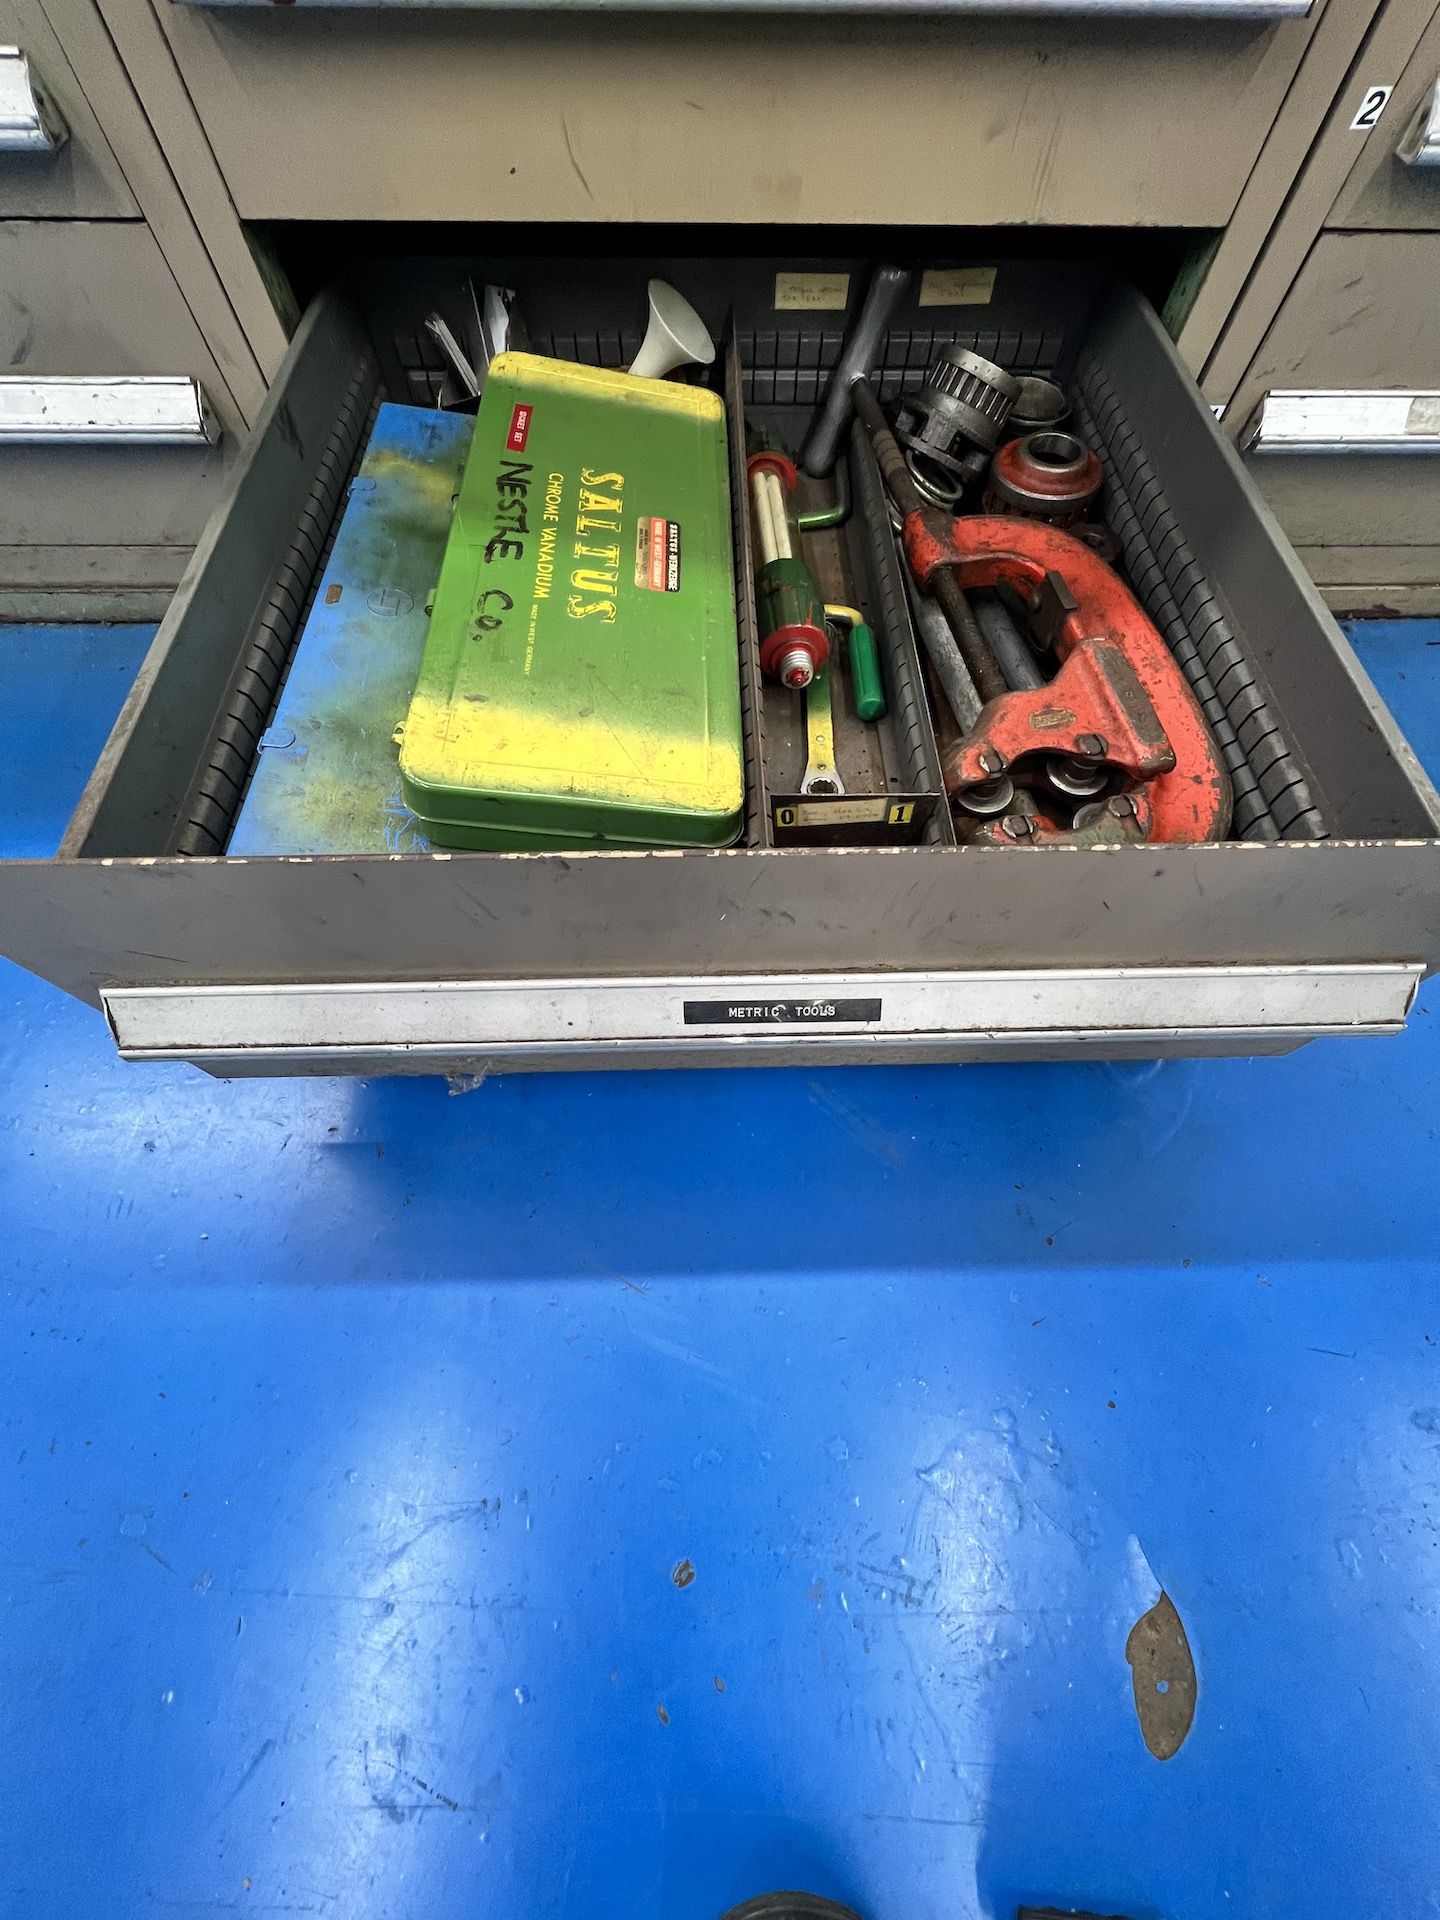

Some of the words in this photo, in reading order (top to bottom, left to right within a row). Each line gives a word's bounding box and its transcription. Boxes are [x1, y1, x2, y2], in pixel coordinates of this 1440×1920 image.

[1356, 90, 1386, 125] 2
[514, 431, 523, 443] SET
[484, 460, 534, 564] NESTLE
[543, 472, 564, 522] CHROME
[567, 467, 625, 624] SALTUS
[533, 527, 558, 599] VANADIUM
[530, 604, 538, 620] MADE
[524, 645, 533, 675] GERMANY
[780, 808, 794, 825] 0
[894, 806, 905, 822] 1
[728, 1006, 780, 1018] METRIC
[795, 1005, 836, 1017] TOOLS
